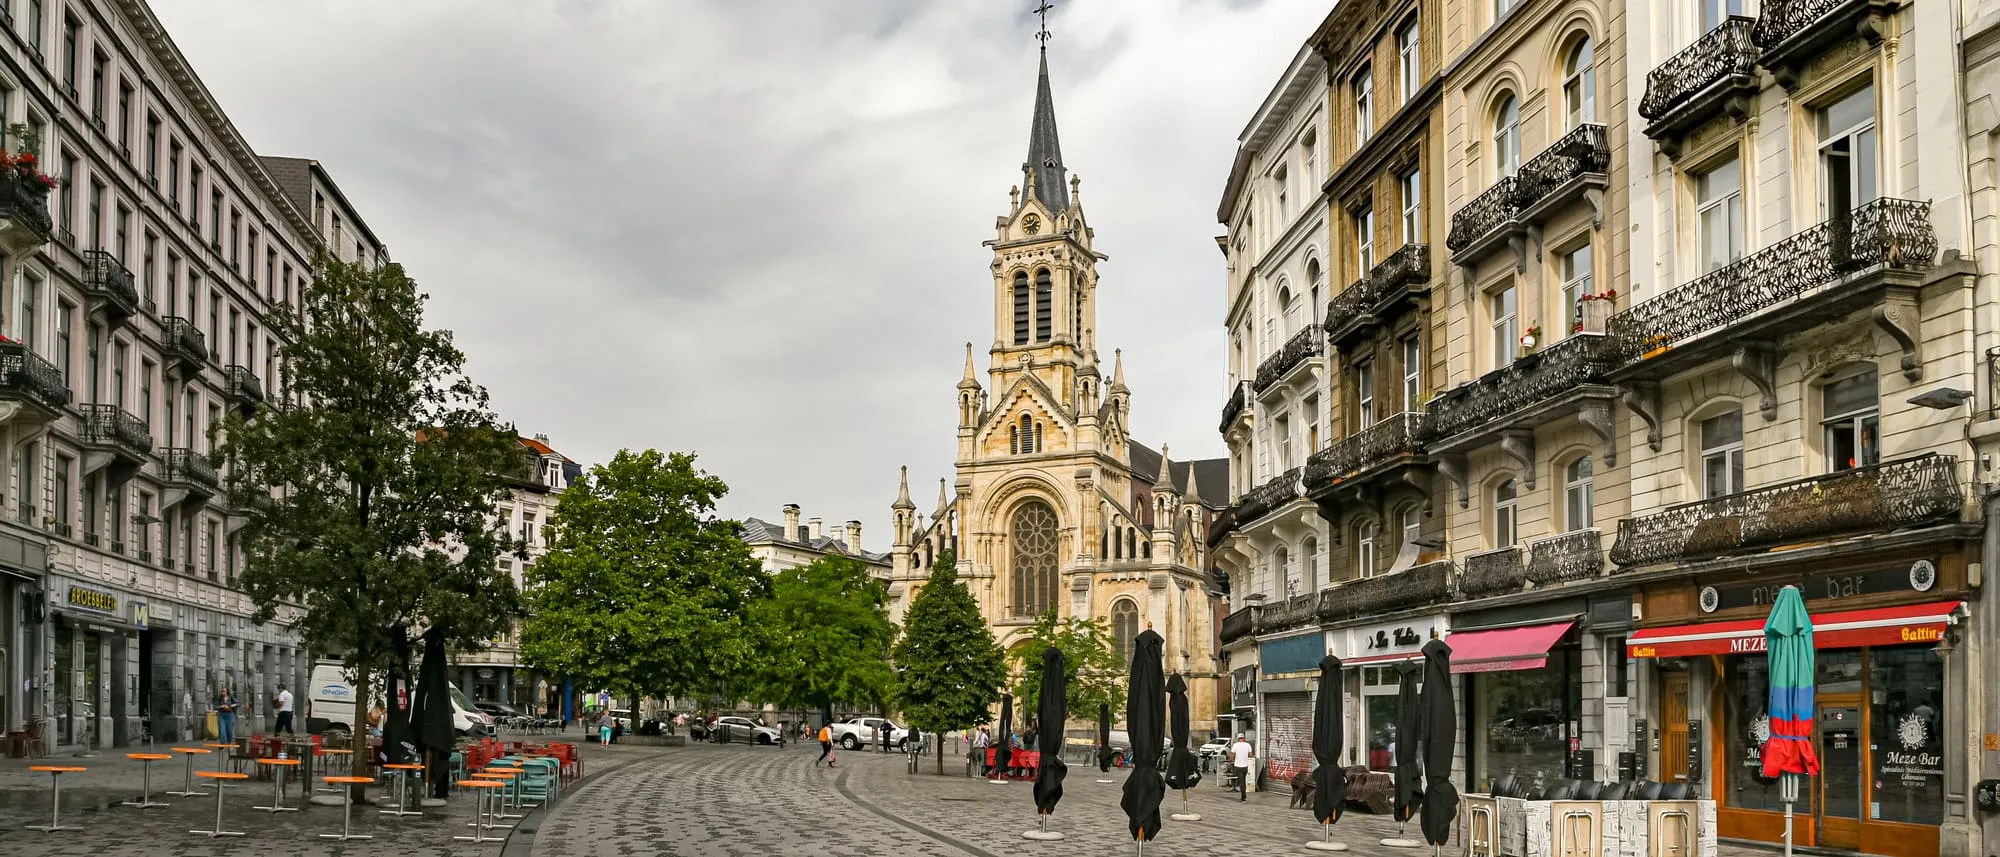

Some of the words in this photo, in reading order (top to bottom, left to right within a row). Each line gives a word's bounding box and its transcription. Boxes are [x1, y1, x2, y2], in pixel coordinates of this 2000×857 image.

[1825, 575, 1863, 600] bar
[1902, 627, 1937, 641] Battin
[1730, 637, 1768, 652] MEZE
[1886, 752, 1917, 765] Meze
[1918, 752, 1941, 766] Bar
